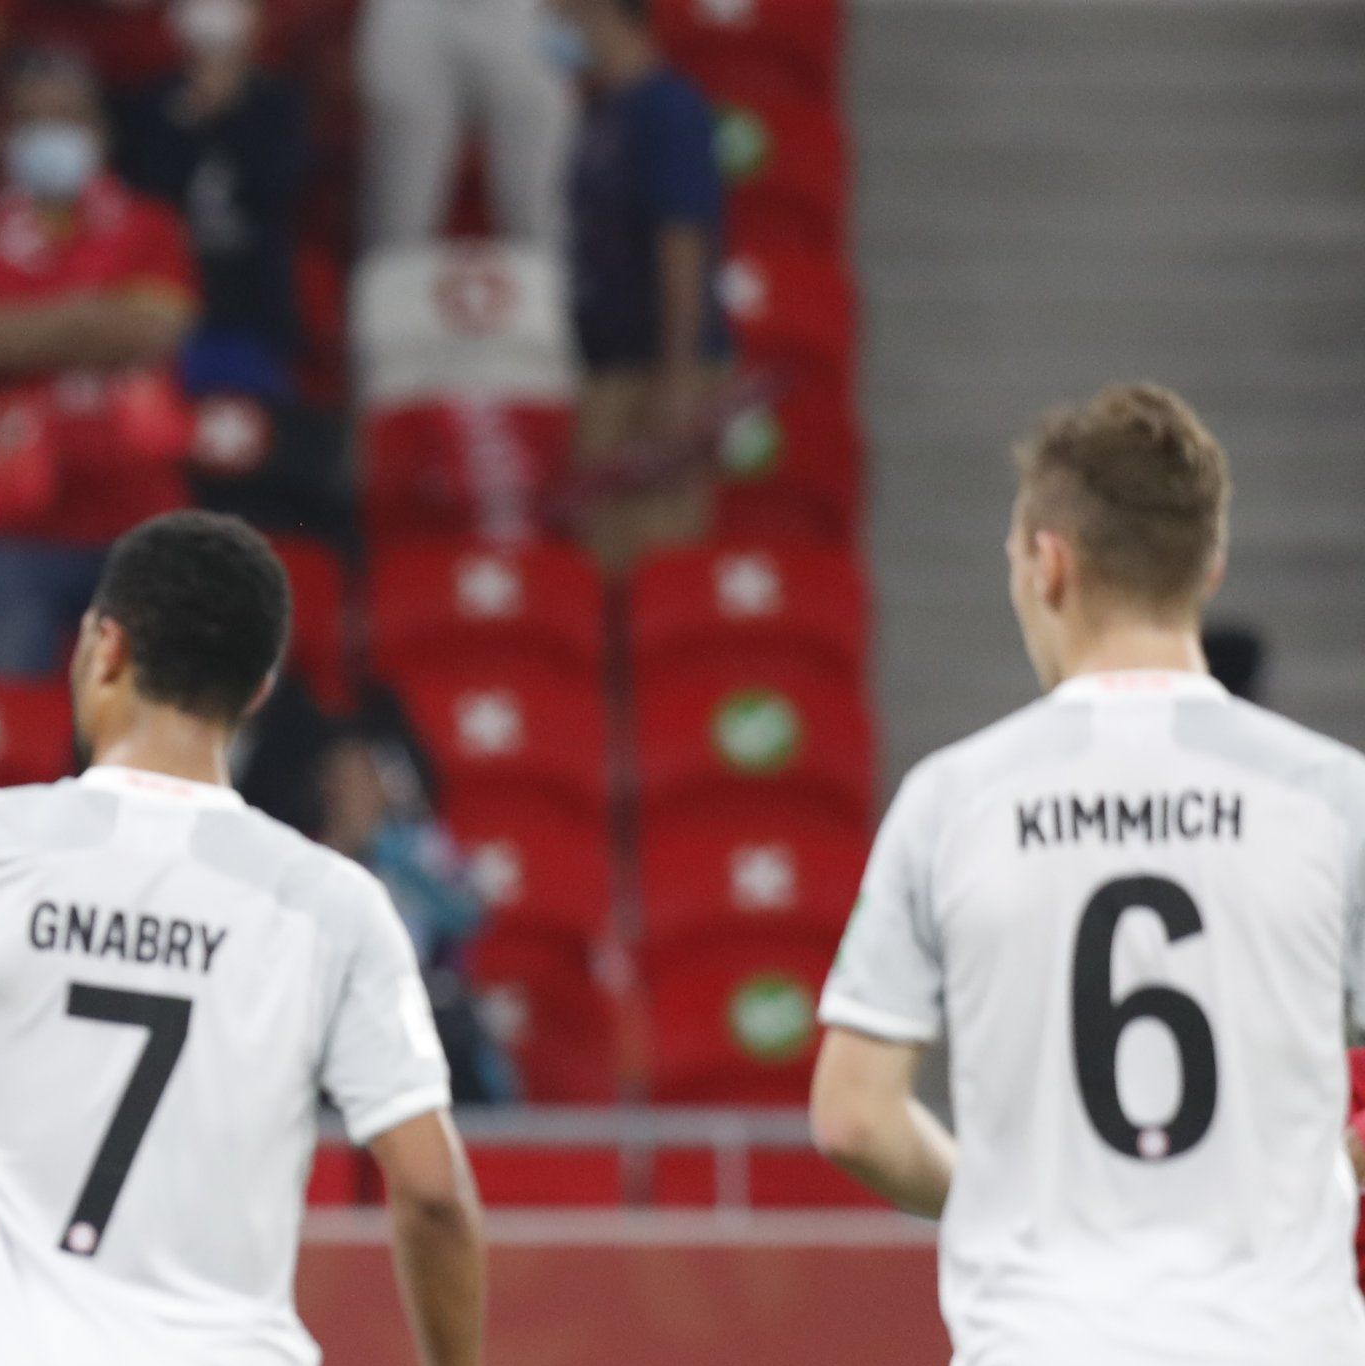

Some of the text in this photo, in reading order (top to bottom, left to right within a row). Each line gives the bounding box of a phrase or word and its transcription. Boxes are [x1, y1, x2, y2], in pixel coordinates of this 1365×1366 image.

[1017, 789, 1241, 848] KIMMICH
[28, 900, 228, 974] GNABRY
[1071, 872, 1219, 1162] 6
[59, 982, 194, 1257] 7
